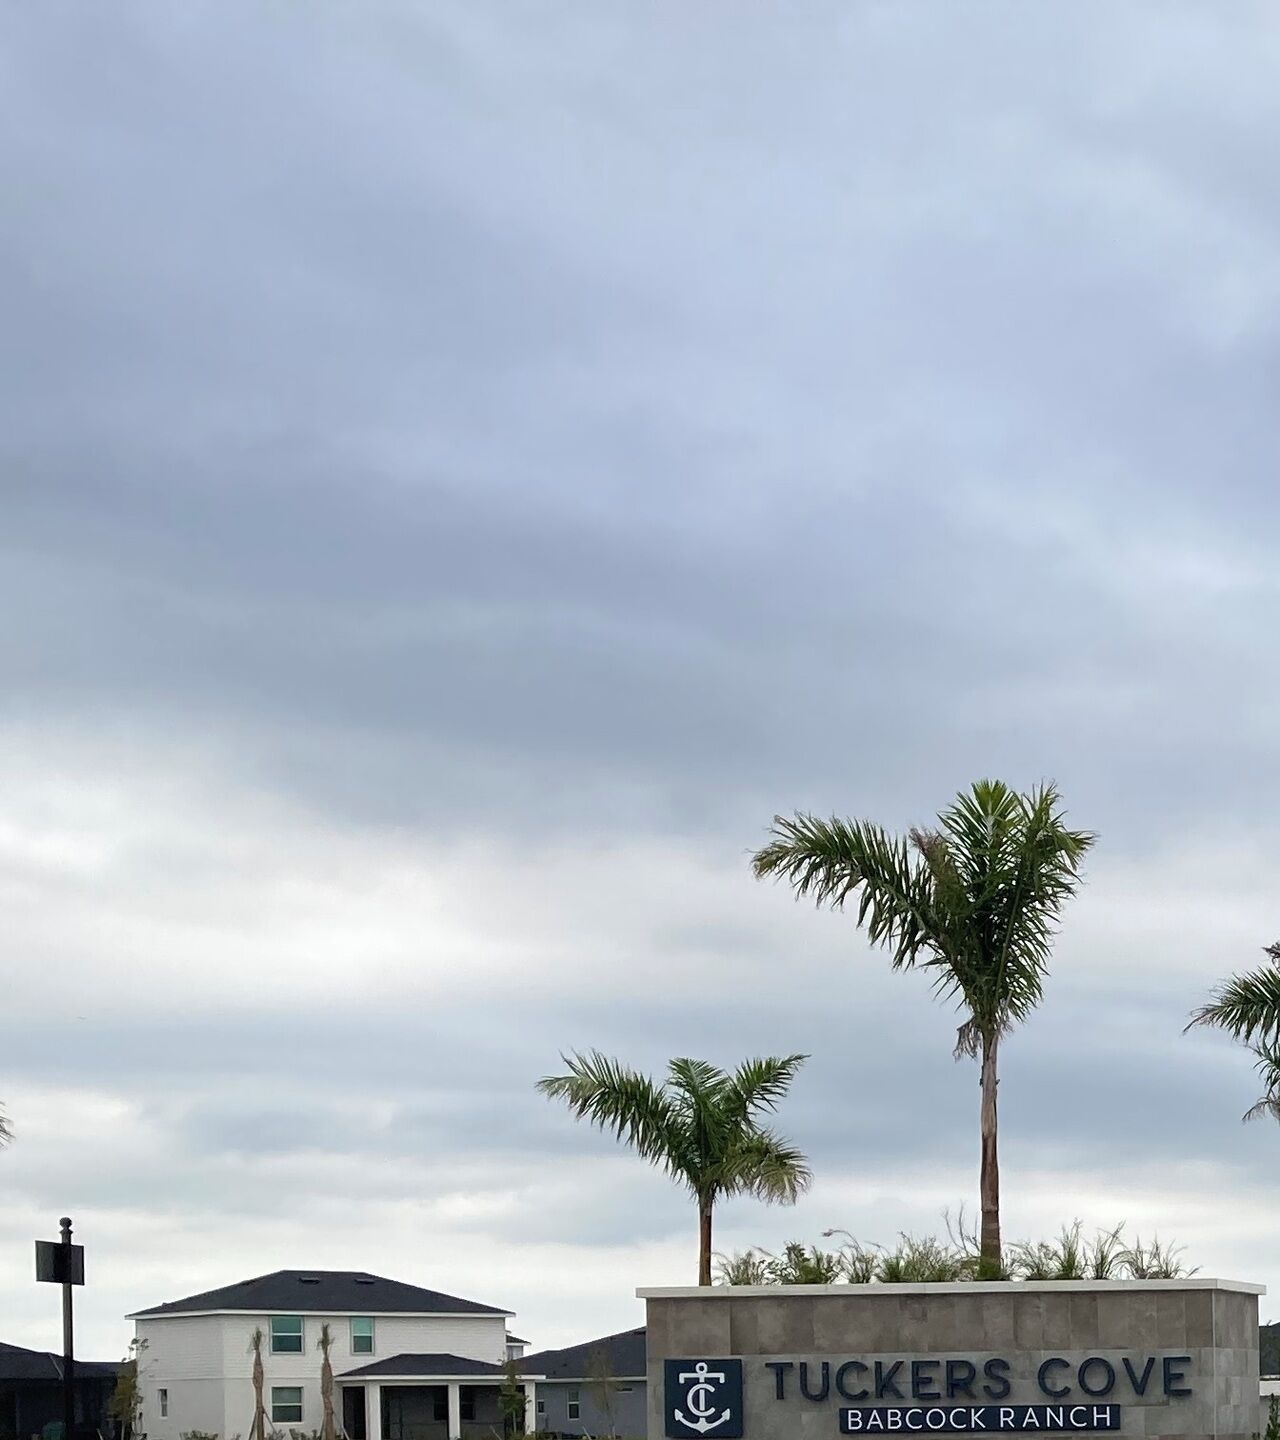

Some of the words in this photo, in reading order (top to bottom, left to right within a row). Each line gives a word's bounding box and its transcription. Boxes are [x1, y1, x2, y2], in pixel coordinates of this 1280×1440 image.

[764, 1358, 1012, 1401] TUCKERS
[1037, 1356, 1194, 1397] COVE
[847, 1408, 988, 1431] BABCOCK
[1000, 1405, 1113, 1429] RANCH
